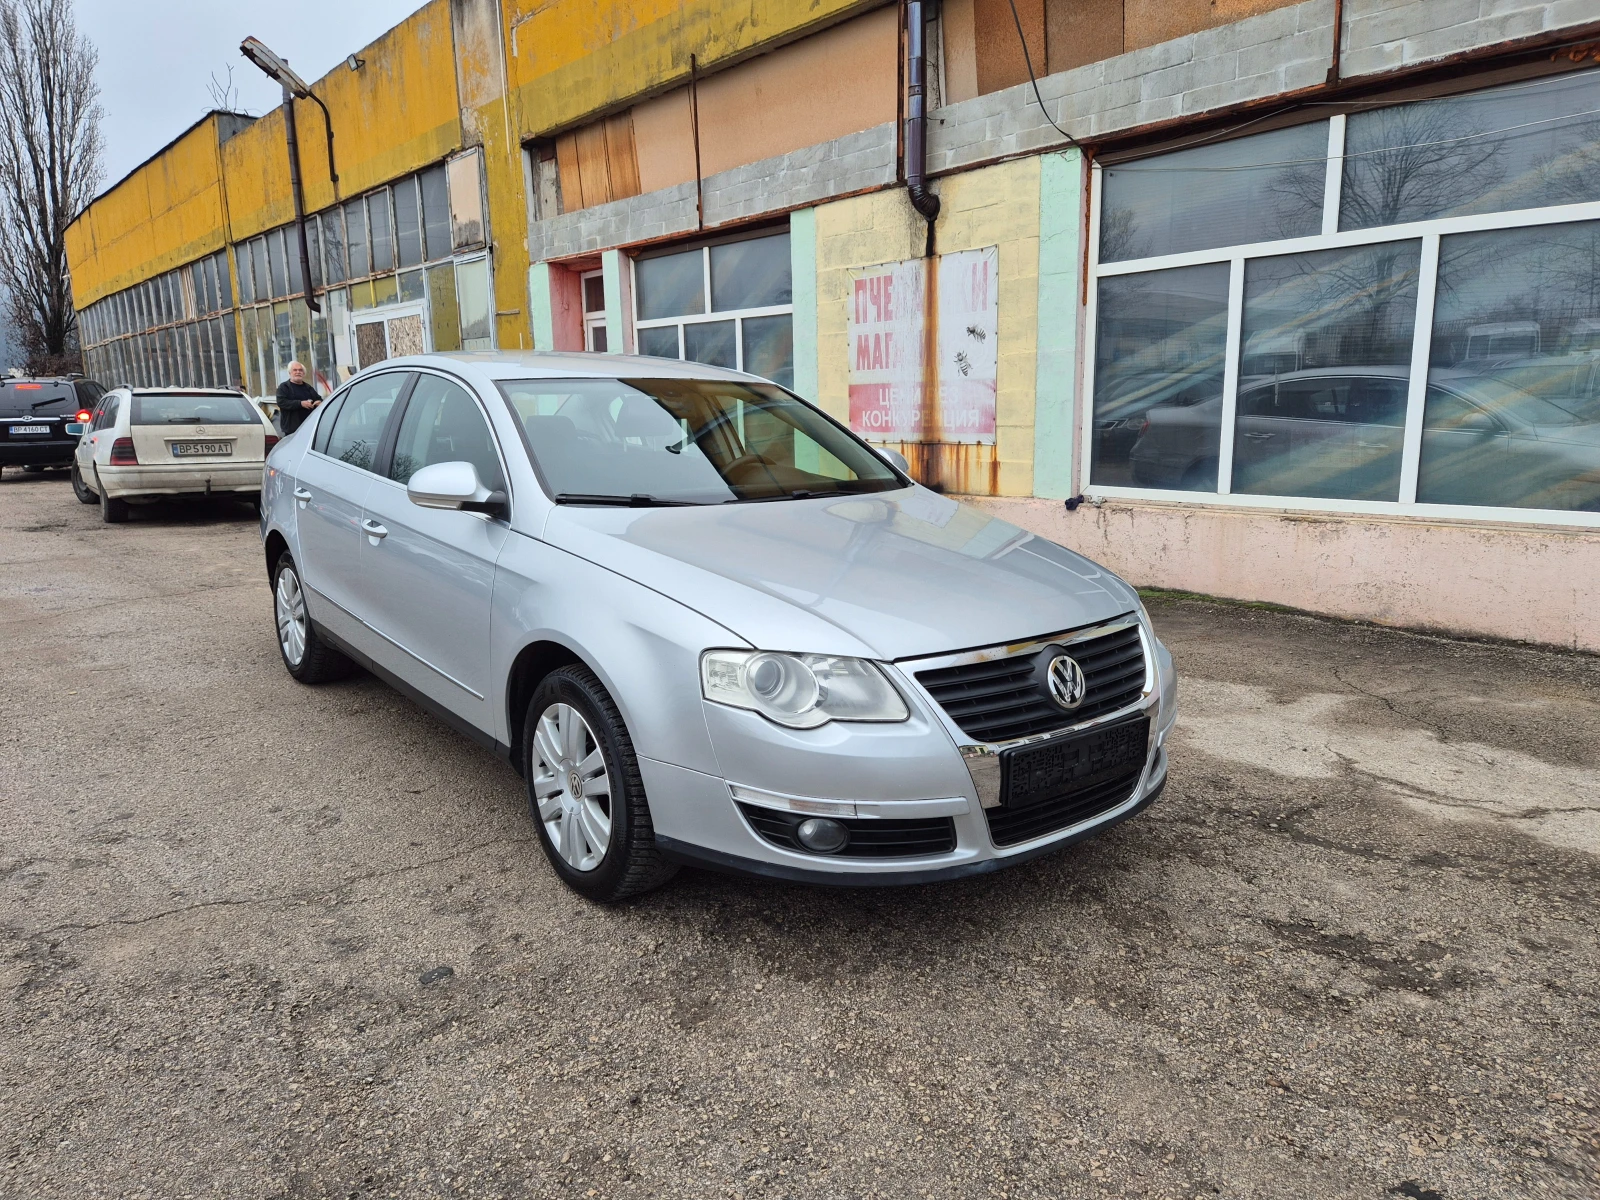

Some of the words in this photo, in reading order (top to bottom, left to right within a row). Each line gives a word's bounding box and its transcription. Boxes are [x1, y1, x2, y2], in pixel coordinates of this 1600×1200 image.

[880, 387, 921, 409] ЦЕИ
[179, 444, 192, 454] BP
[193, 444, 216, 453] 5190
[217, 444, 230, 453] AT
